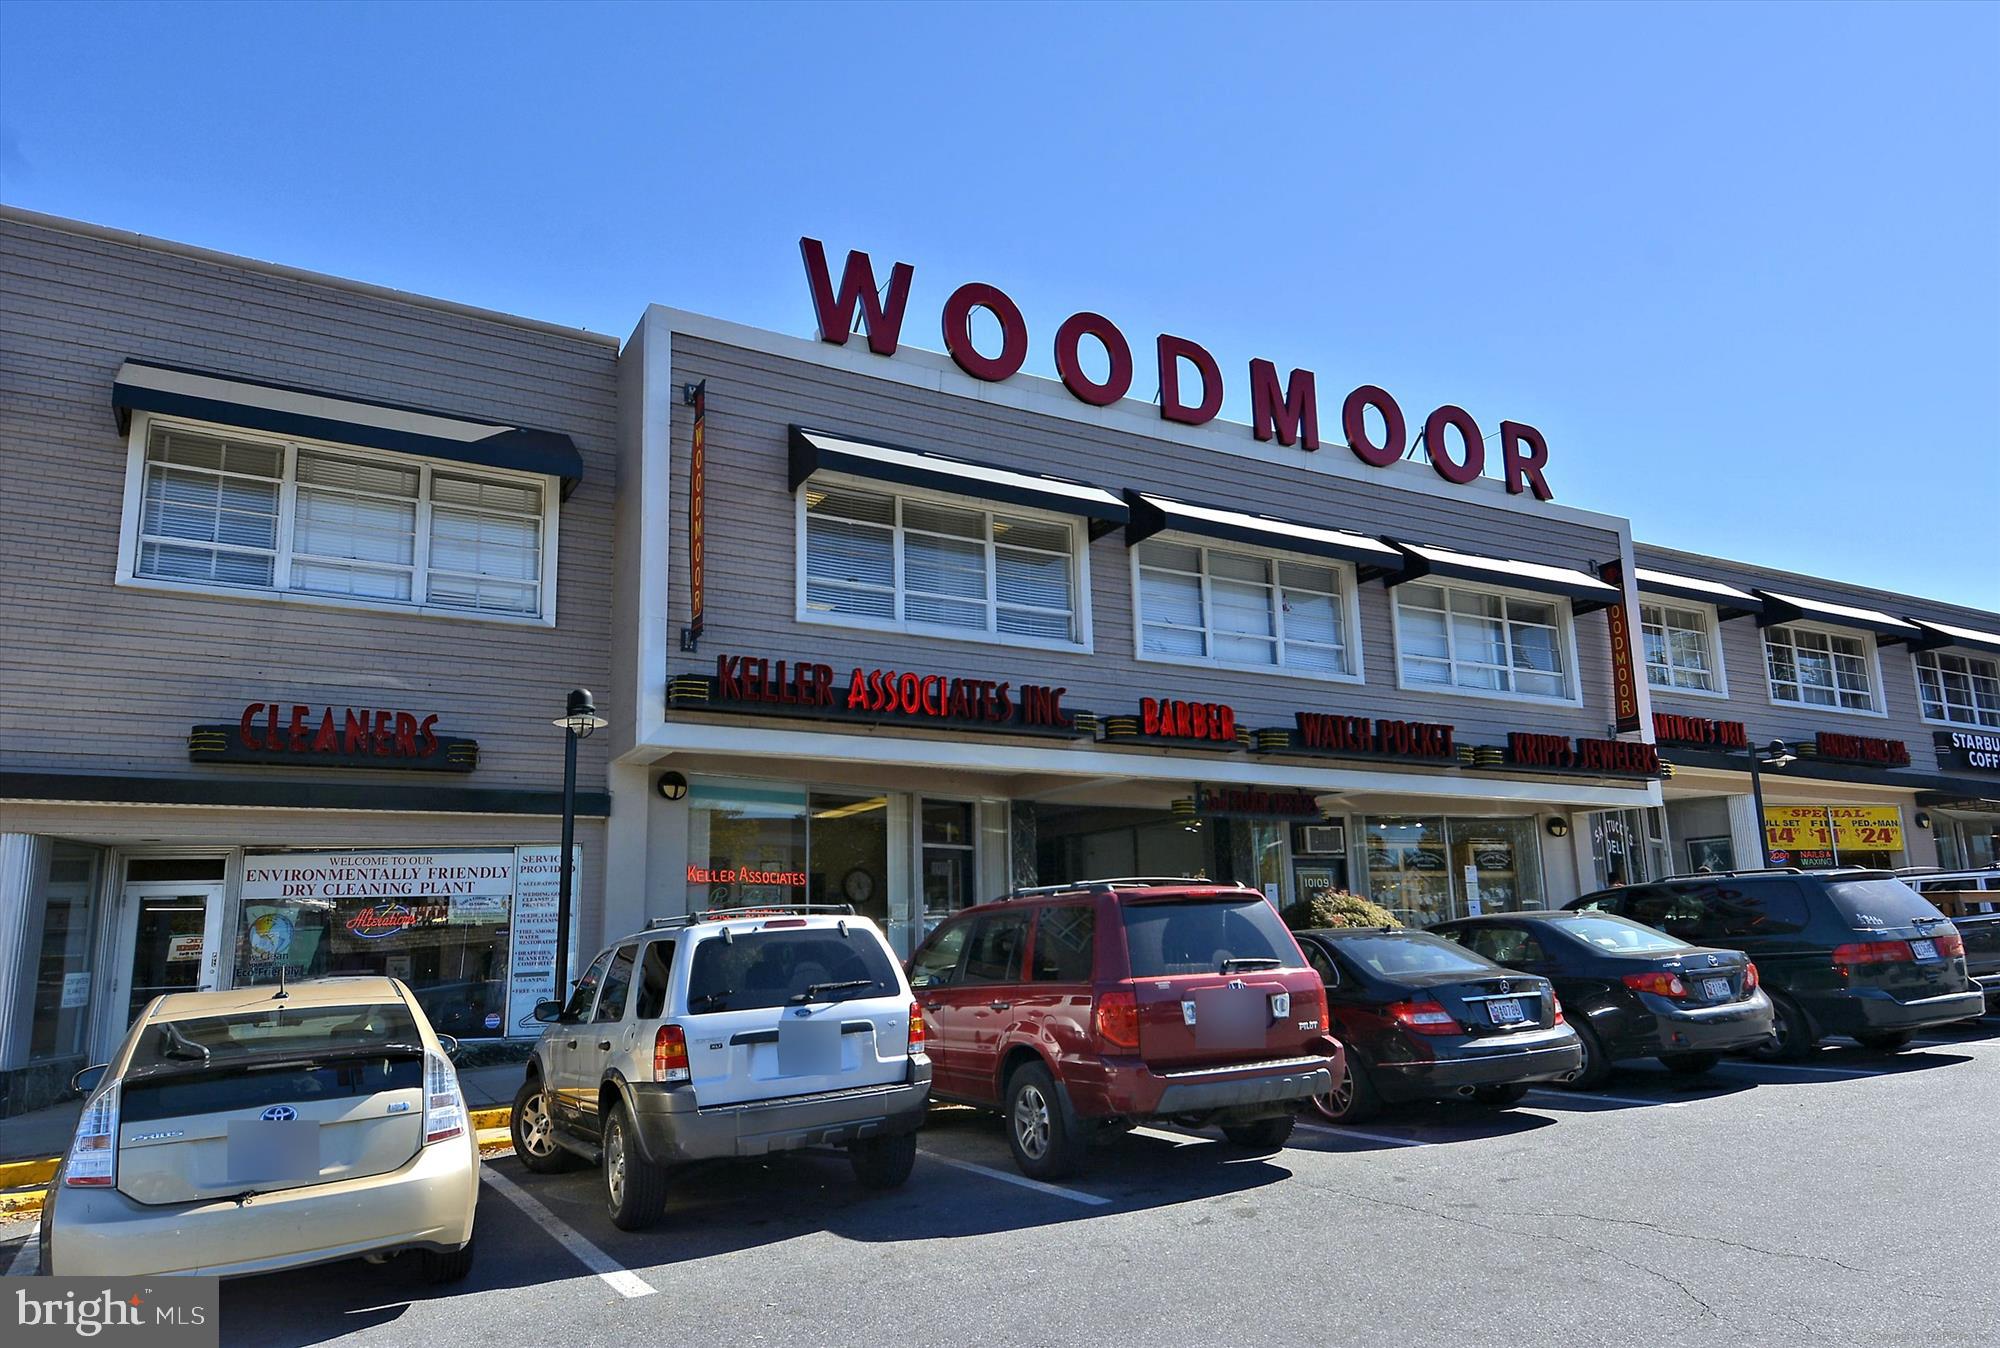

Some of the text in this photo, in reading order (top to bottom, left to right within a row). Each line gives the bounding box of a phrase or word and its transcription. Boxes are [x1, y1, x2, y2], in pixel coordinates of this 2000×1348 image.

[799, 236, 1553, 500] WOODMOOR
[693, 426, 703, 611] WOODMOOR
[1611, 605, 1631, 714] OODMOOR
[718, 654, 834, 705] KELLER
[847, 667, 1015, 721] ASSOCIATES
[1140, 697, 1237, 741] BARBER
[240, 703, 438, 757] CLEANERS
[1296, 711, 1455, 757] WATCH POCKET
[1652, 712, 1747, 748] ANTUCCI'S DELI
[1577, 738, 1661, 773] JEWELERS
[1969, 751, 2000, 768] COFF
[1791, 809, 1865, 818] SPECIAL
[329, 857, 433, 866] WELCOME TO OUR
[522, 855, 574, 864] SERVIC
[1800, 851, 1825, 859] NAILS
[1801, 858, 1833, 867] WAXING
[246, 866, 511, 882] ENVIRONMENTALLY FRIENDLY
[520, 865, 576, 874] PROVIDD
[687, 864, 806, 886] KELLER ASSOCIATES
[282, 881, 475, 897] DRY CLEANING PLANT
[1304, 878, 1330, 888] 10109
[346, 906, 416, 929] Alterations
[1298, 1021, 1319, 1031] PILOT
[131, 1130, 185, 1142] PRIUS
